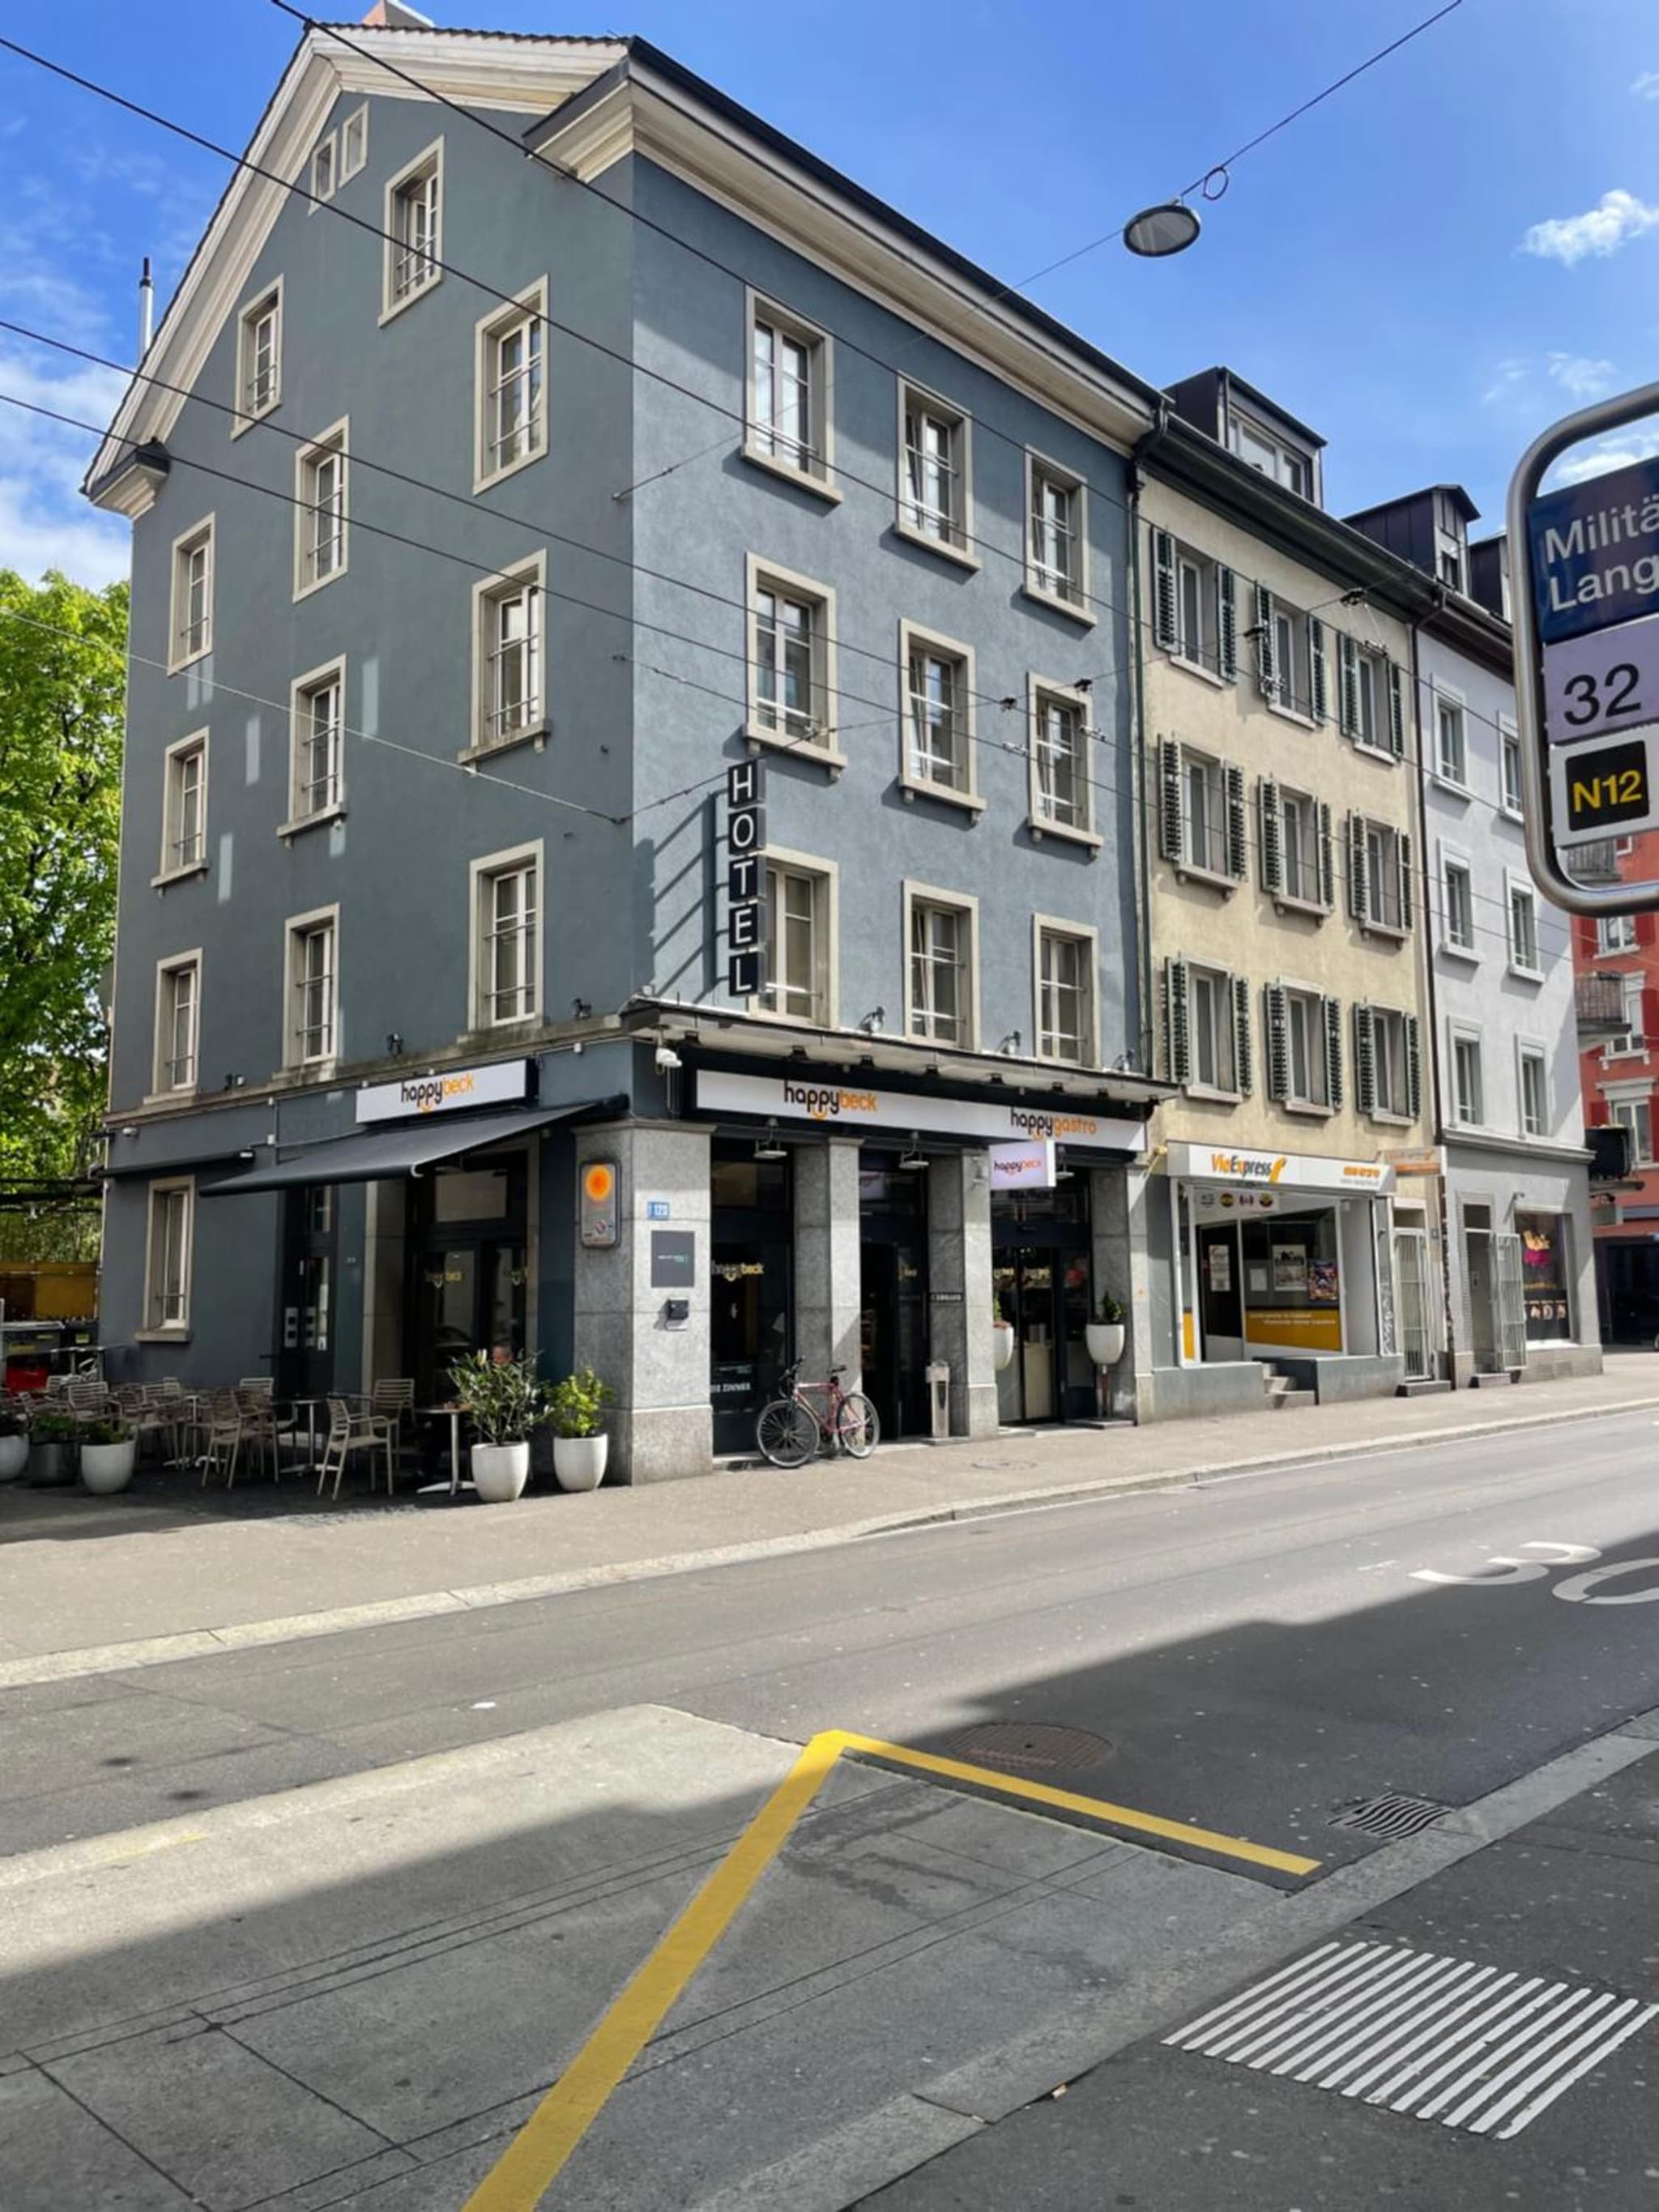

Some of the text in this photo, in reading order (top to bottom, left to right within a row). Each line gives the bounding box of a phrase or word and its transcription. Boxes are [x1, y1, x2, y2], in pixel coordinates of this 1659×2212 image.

[1563, 663, 1641, 726] 32
[1573, 769, 1642, 812] N12
[732, 765, 754, 992] HOTEL
[401, 1072, 474, 1107] happybeck
[784, 1078, 877, 1115] happybeck
[1010, 1106, 1097, 1137] happygastro
